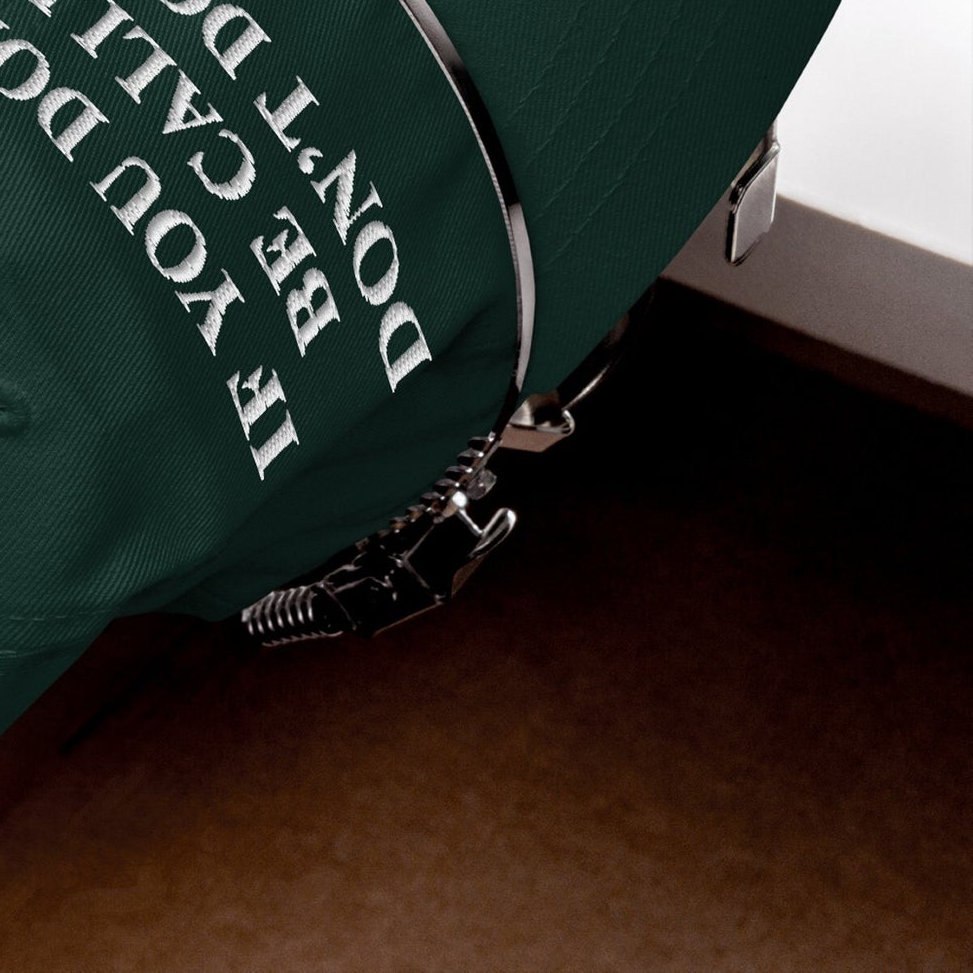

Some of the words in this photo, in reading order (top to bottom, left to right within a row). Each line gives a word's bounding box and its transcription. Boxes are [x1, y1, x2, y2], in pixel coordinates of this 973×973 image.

[89, 156, 246, 357] YOU
[249, 205, 341, 358] BE
[253, 75, 433, 395] DON'T
[226, 365, 300, 481] IF
